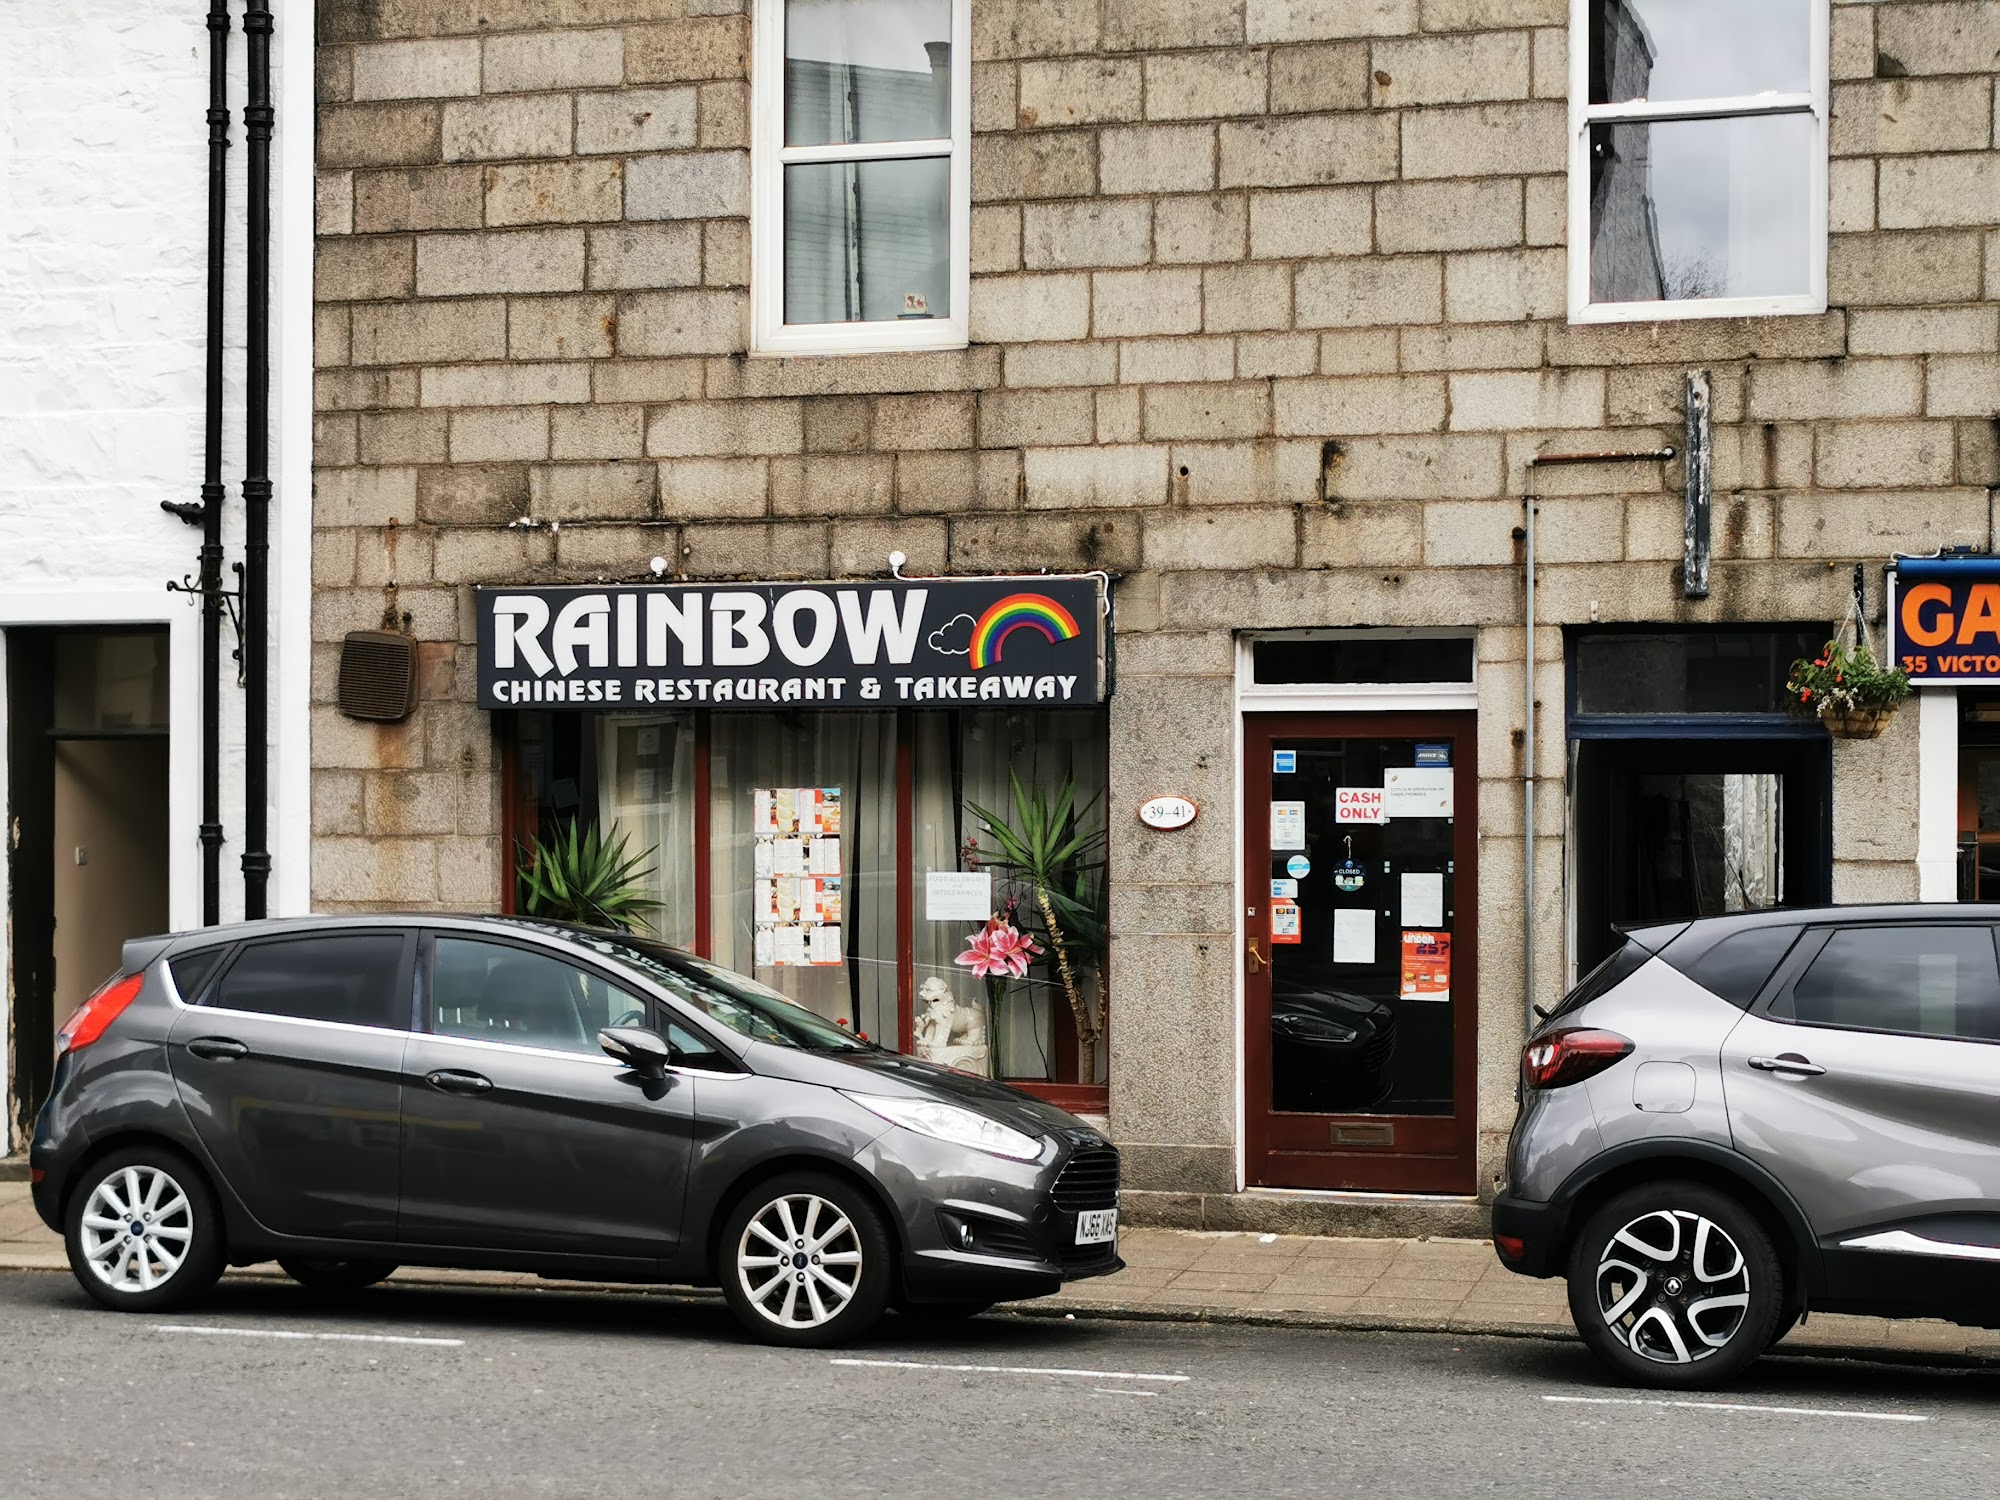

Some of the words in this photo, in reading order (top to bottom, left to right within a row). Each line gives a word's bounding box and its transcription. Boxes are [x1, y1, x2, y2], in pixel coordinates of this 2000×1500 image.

[492, 589, 929, 678] RAINBOW
[1902, 655, 1928, 673] 35
[492, 679, 622, 704] CHINESE
[635, 678, 847, 703] RESTAURANT
[860, 677, 882, 699] &
[895, 676, 1078, 702] TAKEAWAY
[1339, 792, 1382, 804] CASH
[1149, 805, 1187, 819] 39-41
[1340, 807, 1380, 819] ONLY
[1080, 1214, 1101, 1238] NJ66
